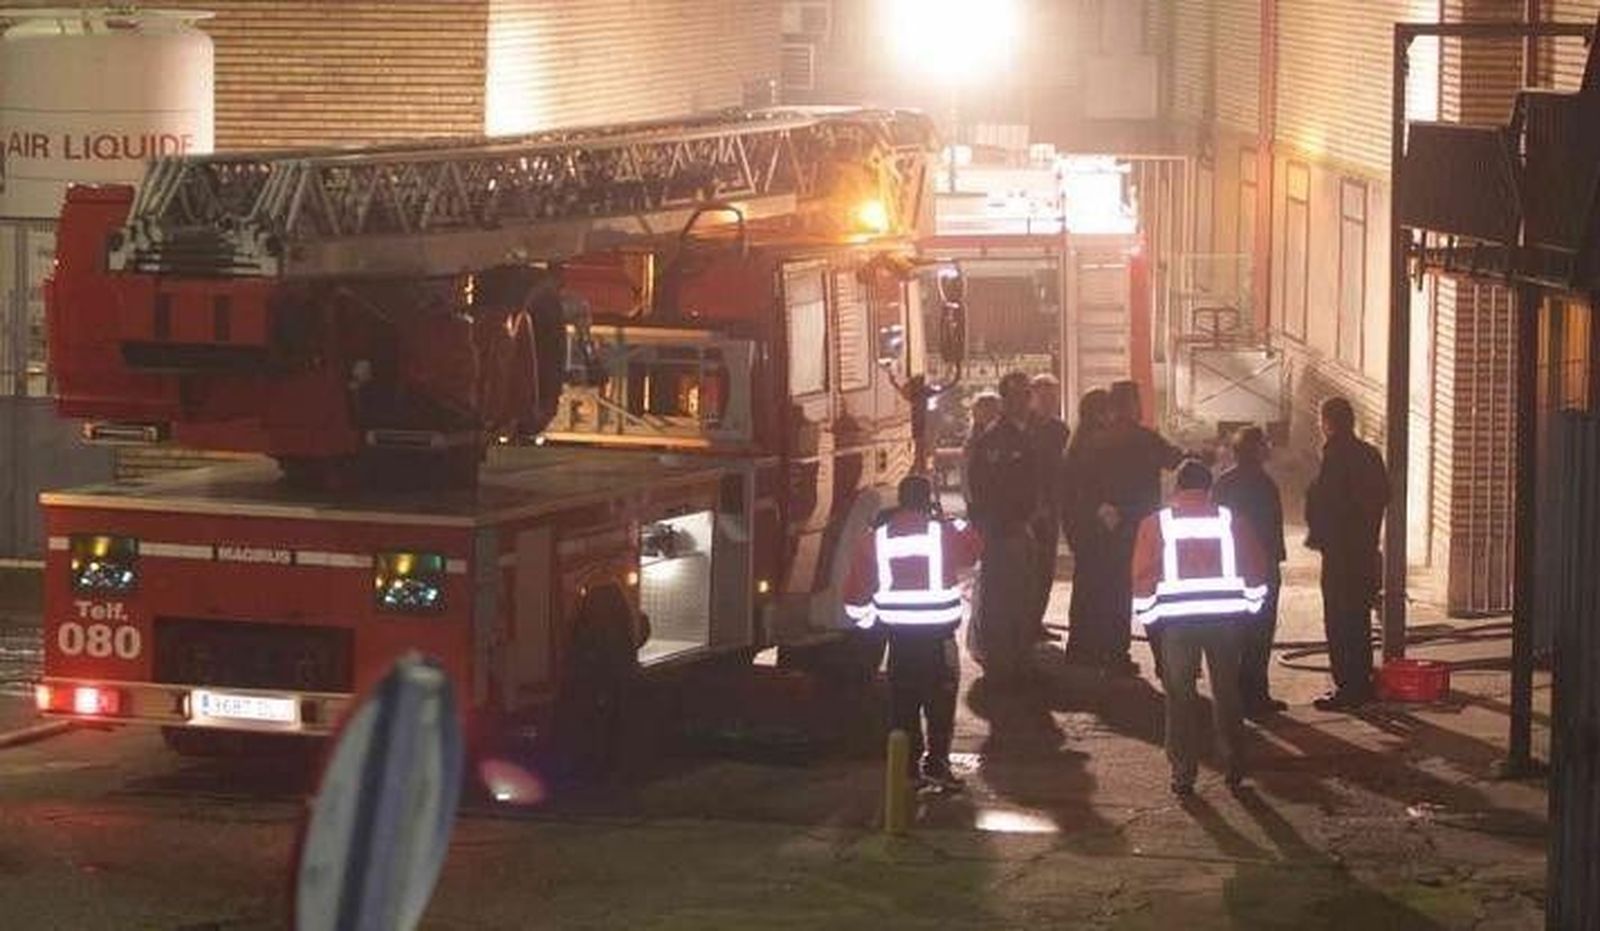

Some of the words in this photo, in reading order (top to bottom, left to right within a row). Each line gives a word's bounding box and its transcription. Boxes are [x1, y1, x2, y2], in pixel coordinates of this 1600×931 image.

[8, 132, 50, 158] AIR
[64, 133, 194, 160] LIQUIDE
[75, 600, 128, 620] Telf.
[58, 621, 141, 660] 080
